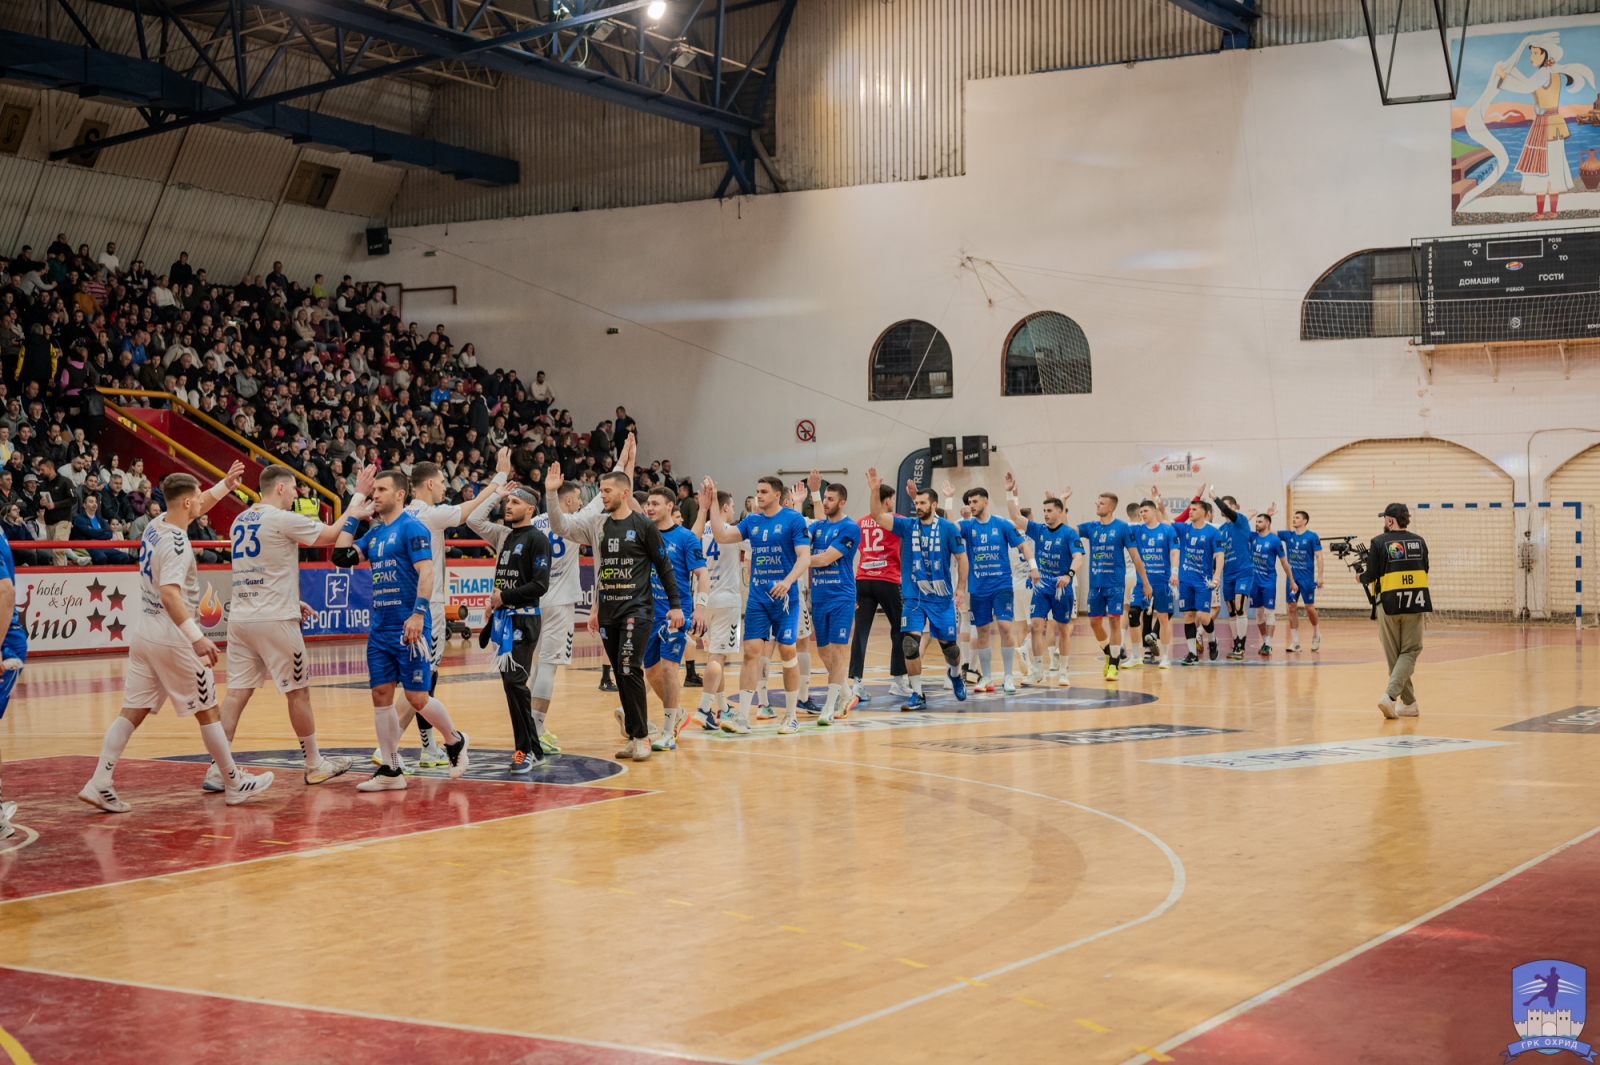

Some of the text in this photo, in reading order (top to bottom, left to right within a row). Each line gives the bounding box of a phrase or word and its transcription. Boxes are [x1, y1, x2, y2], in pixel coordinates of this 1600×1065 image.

[1459, 277, 1499, 287] ДОМАШНИ
[1538, 273, 1564, 281] ГОСТИ
[232, 524, 261, 559] 23
[762, 529, 768, 542] 6
[863, 528, 884, 552] 12
[981, 534, 988, 543] 21
[608, 538, 619, 552] 56
[1402, 575, 1414, 585] HB
[36, 579, 68, 596] hotel
[48, 595, 83, 615] & spa
